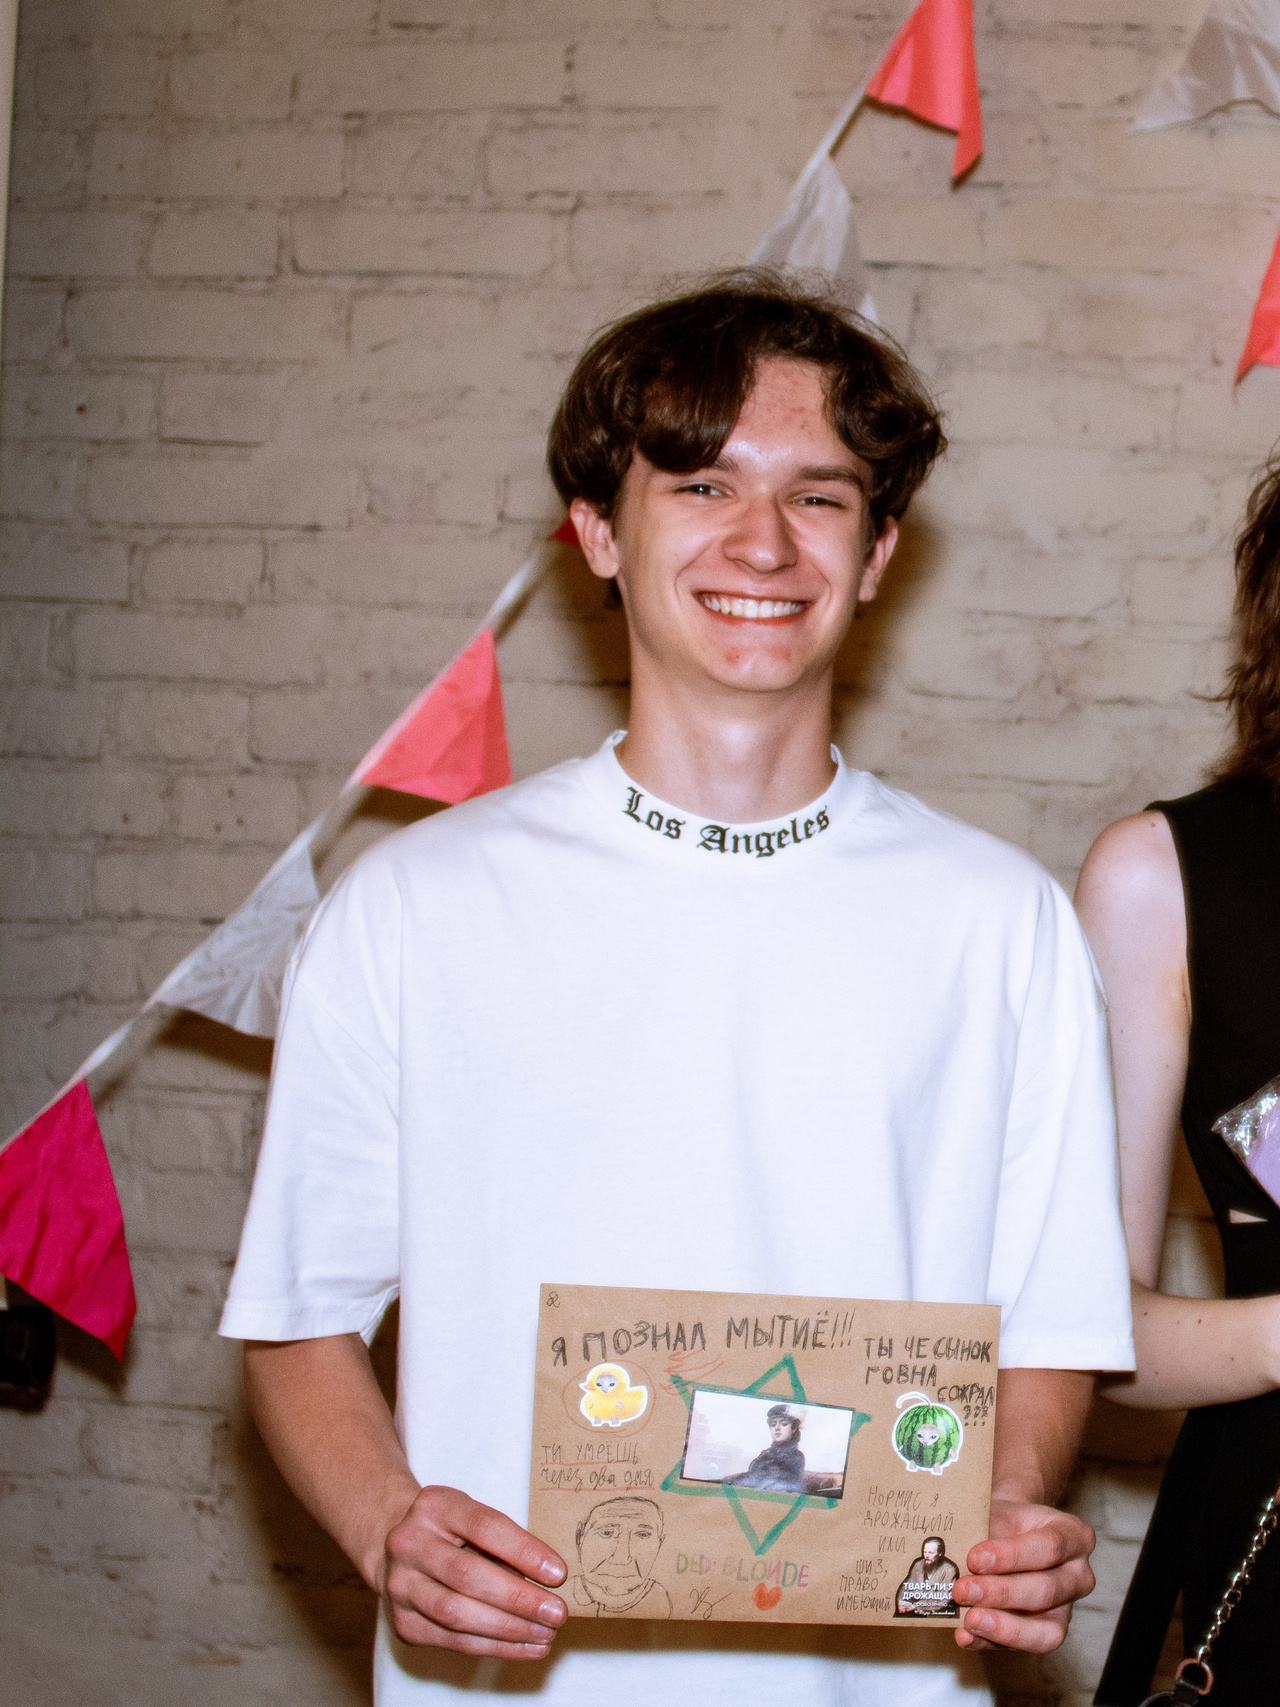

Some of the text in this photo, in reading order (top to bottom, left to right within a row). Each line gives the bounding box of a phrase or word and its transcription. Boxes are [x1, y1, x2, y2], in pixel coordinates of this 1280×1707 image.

[622, 786, 831, 858] Los Angeles
[552, 1307, 856, 1366] Я ПОЗНАЛ МЫТИЁ!!!
[863, 1336, 993, 1363] ТЫ ЧЕ СЫНОК
[865, 1363, 938, 1387] ГОВНА
[937, 1382, 996, 1406] СОЖРАЛ
[576, 1440, 639, 1466] УМРЁШЬ
[589, 1466, 617, 1491] два
[839, 1575, 879, 1592] ПРАВО
[903, 1582, 931, 1590] ТВАРЬ
[933, 1582, 946, 1590] ЛИ
